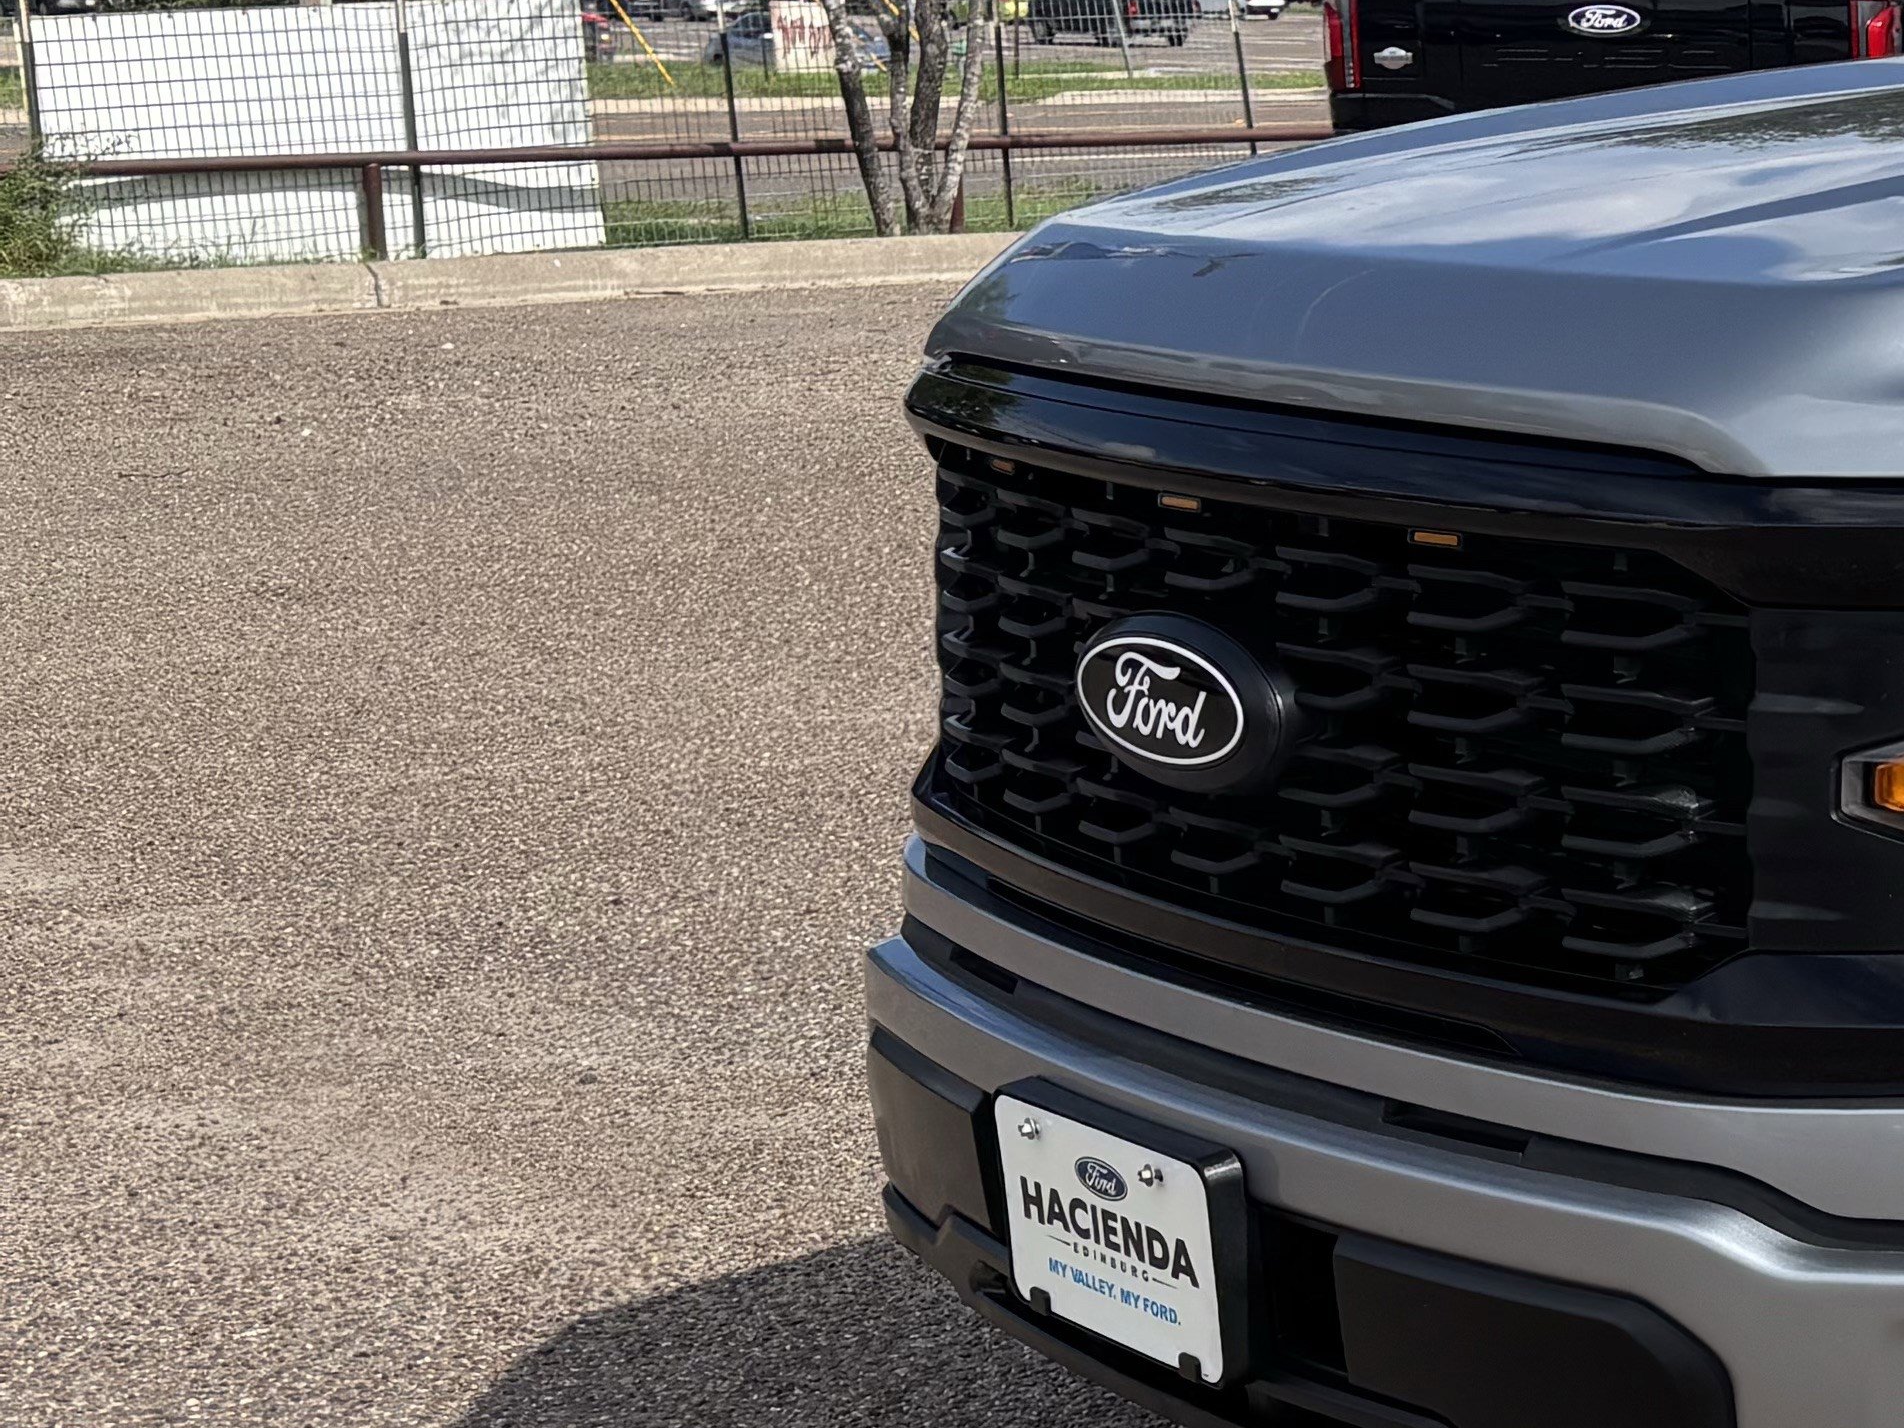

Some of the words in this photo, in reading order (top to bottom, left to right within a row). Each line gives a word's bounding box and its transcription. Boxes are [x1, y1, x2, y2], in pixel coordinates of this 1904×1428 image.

[1581, 9, 1628, 29] Ford
[1106, 651, 1208, 749] Ford
[1085, 1162, 1118, 1196] Ford
[1019, 1175, 1200, 1290] HACIENDA
[1073, 1241, 1150, 1283] EDINBURG
[1049, 1256, 1068, 1278] MY
[1120, 1287, 1141, 1310] MY
[1143, 1297, 1182, 1326] FORD.
